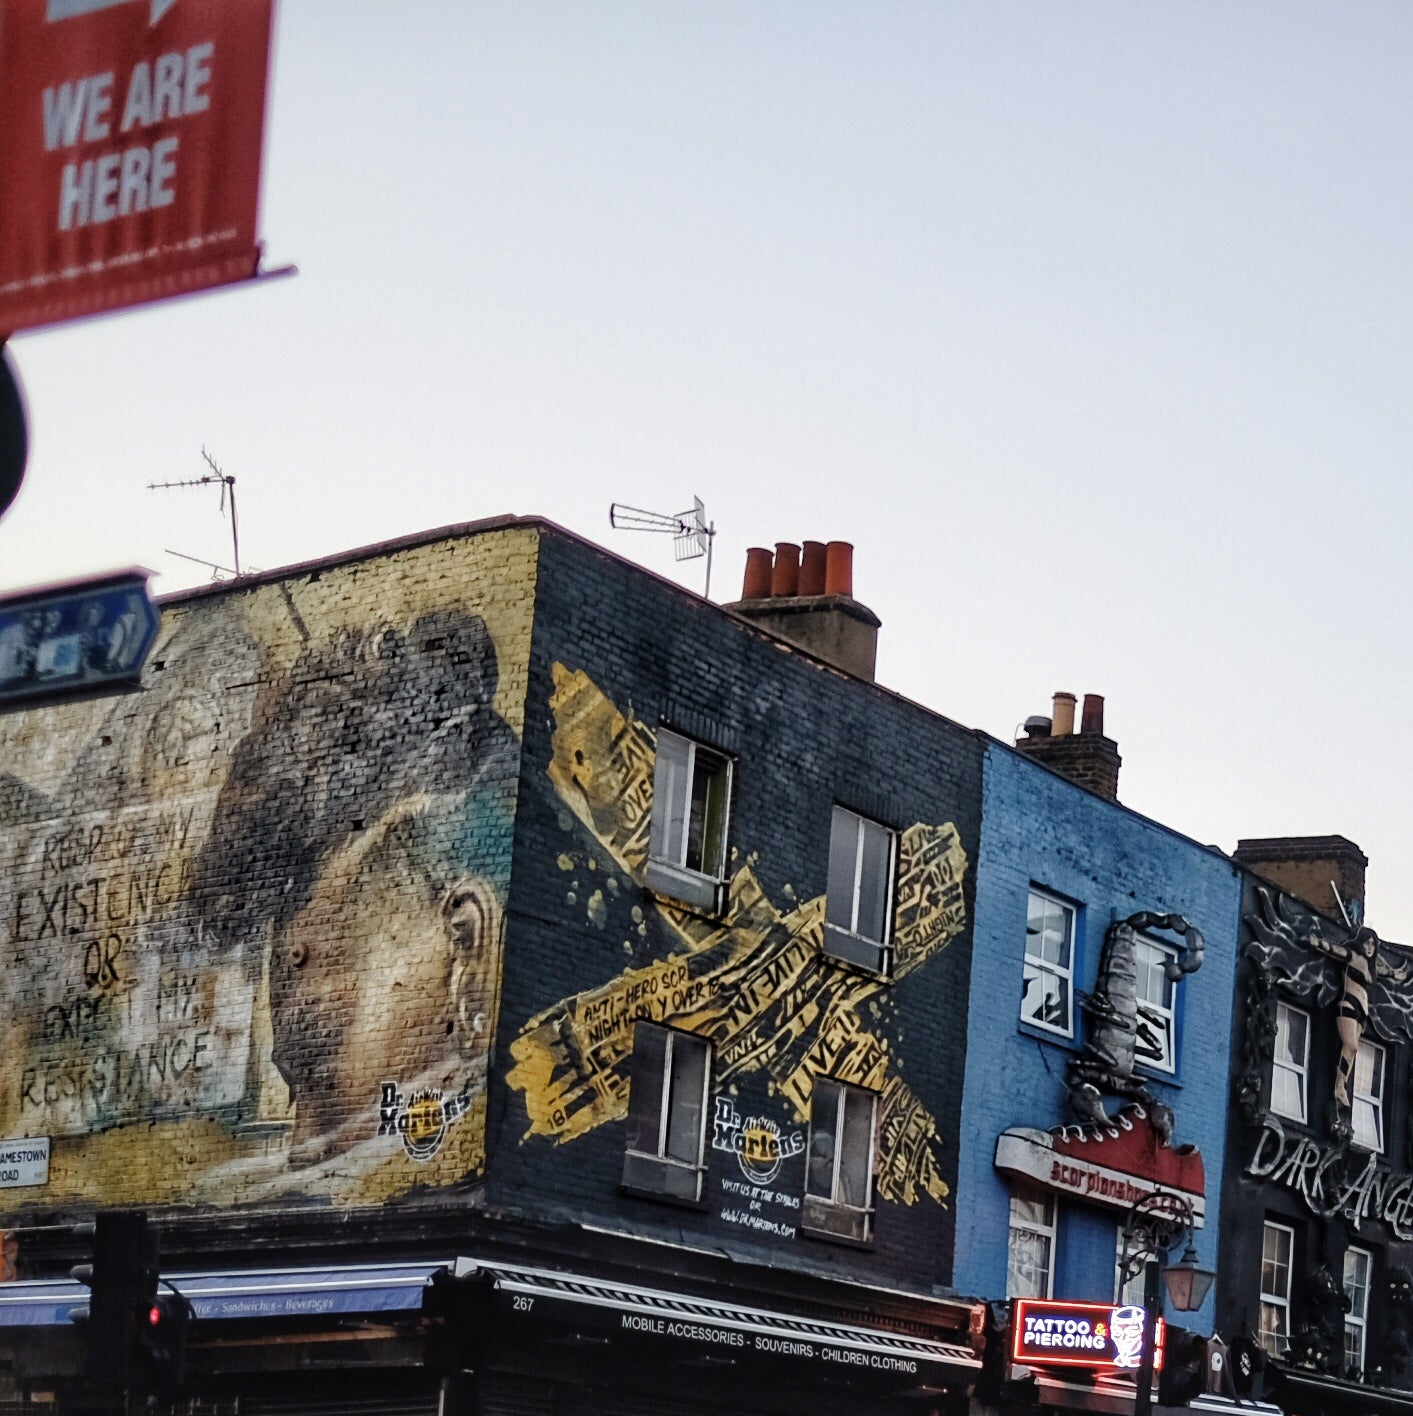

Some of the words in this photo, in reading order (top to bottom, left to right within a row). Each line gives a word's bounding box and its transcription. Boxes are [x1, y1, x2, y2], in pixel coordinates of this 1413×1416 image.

[42, 71, 115, 150] WE
[120, 42, 214, 133] ARE
[58, 136, 179, 231] HERE
[712, 1130, 806, 1159] Martens
[1245, 1113, 1343, 1215] DARK
[222, 1301, 276, 1313] Sandwiches
[285, 1298, 335, 1312] Beverages
[513, 1295, 534, 1312] 267
[1023, 1332, 1106, 1350] PIERCING
[1025, 1317, 1091, 1335] TATTOO
[1094, 1323, 1106, 1337] &
[621, 1314, 665, 1335] MOBILE
[667, 1322, 745, 1348] ACCESSORIES
[755, 1337, 814, 1359] SOUVENIRS
[821, 1347, 870, 1367] CHILDREN
[871, 1354, 918, 1374] CLOTHING
